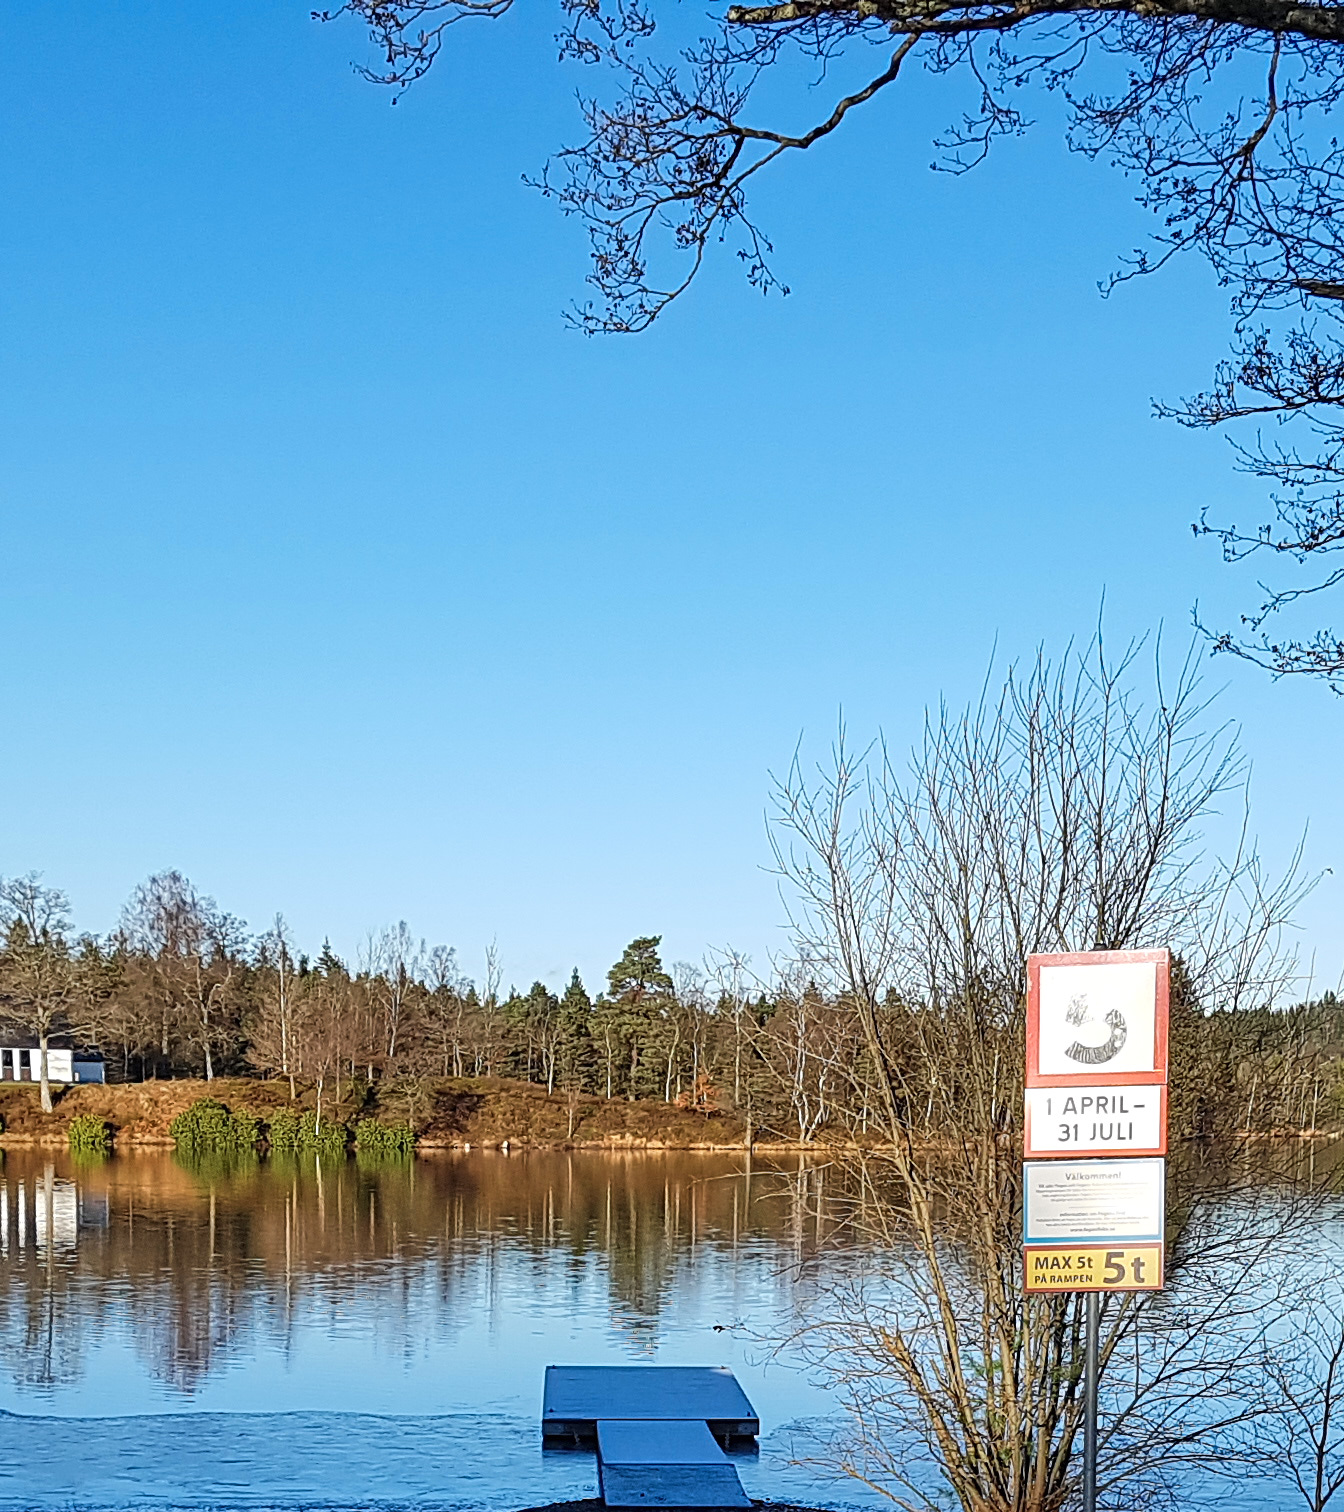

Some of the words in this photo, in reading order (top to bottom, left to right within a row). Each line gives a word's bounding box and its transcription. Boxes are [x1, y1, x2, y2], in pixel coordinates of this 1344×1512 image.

[1046, 1097, 1052, 1115] 1
[1058, 1123, 1078, 1142] 31
[1089, 1122, 1133, 1141] JULI
[1065, 1171, 1122, 1181] Välkommen!
[1035, 1256, 1072, 1270] MAX
[1076, 1256, 1094, 1269] 5t
[1103, 1251, 1145, 1284] 5t
[1034, 1273, 1047, 1284] PÅ
[1049, 1274, 1093, 1283] RAMPEN
